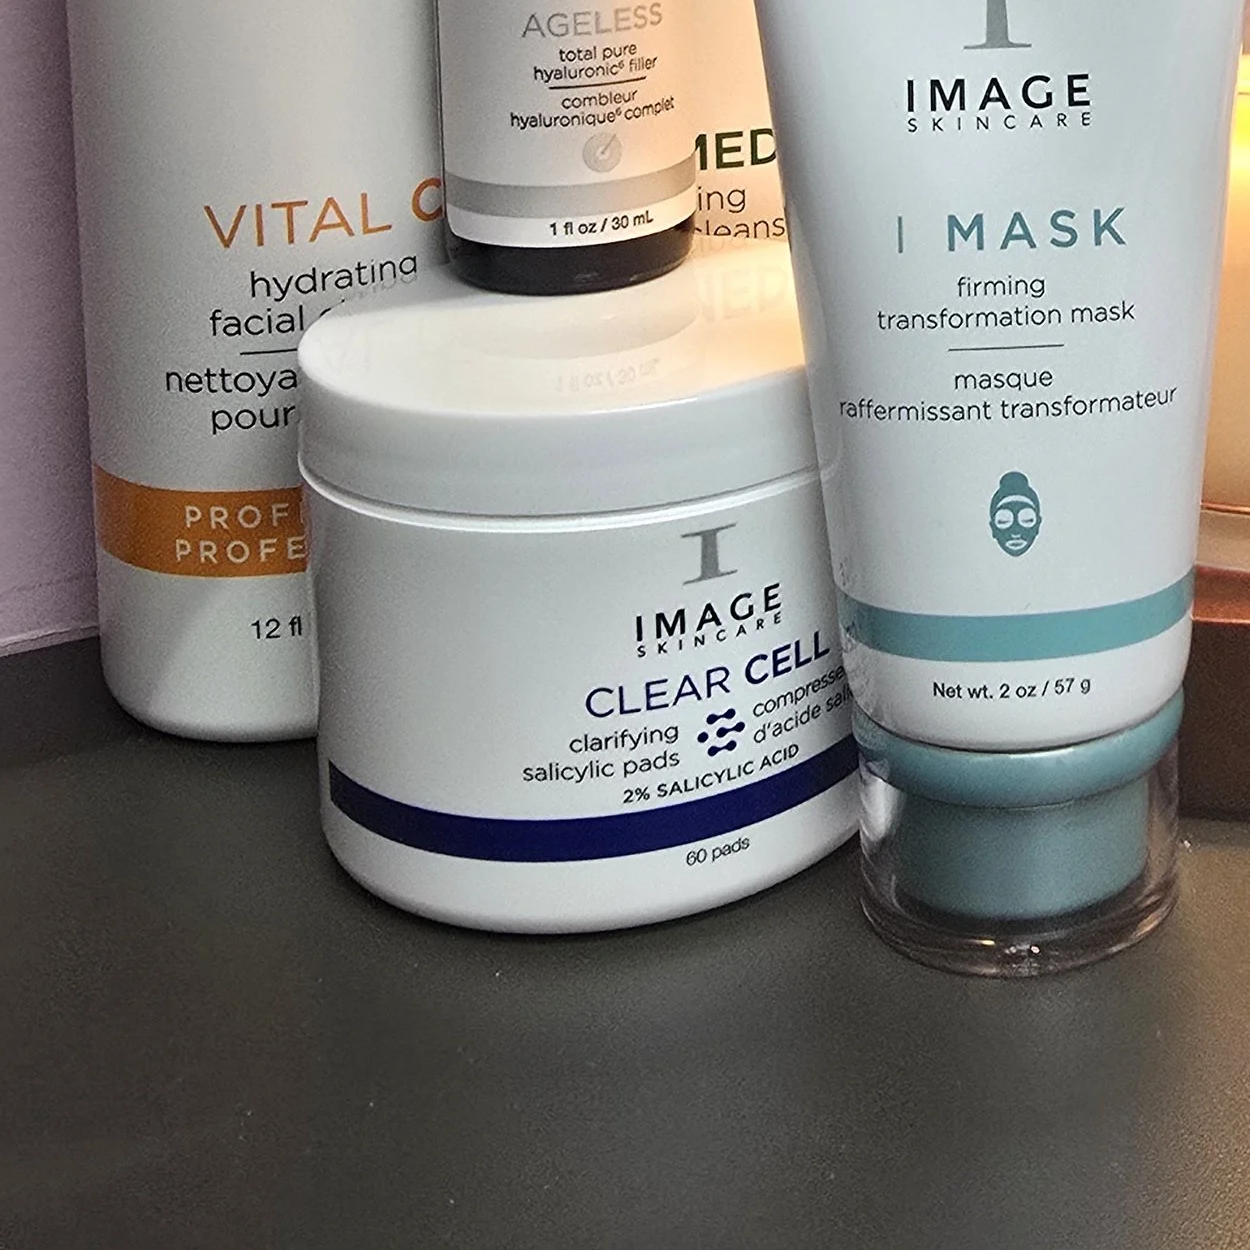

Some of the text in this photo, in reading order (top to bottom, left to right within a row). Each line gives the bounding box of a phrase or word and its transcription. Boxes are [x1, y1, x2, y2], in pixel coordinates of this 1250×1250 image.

[521, 2, 663, 39] AGELESS
[559, 43, 637, 63] total pure
[629, 56, 658, 72] filler
[561, 90, 638, 111] combleur
[624, 96, 675, 121] complet
[907, 73, 1091, 113] IMAGE
[907, 111, 1091, 133] SKINCARE
[203, 177, 442, 249] VITAL C
[550, 210, 654, 236] 1 fl oz / 30 mL
[947, 206, 1127, 252] MASK
[250, 255, 418, 302] hydrating
[957, 274, 1046, 298] firming
[210, 304, 305, 336] facial
[877, 300, 1136, 330] transformation mask
[954, 369, 1053, 392] masque
[211, 404, 296, 435] pour
[839, 386, 1178, 422] raffermissant transformateur
[251, 615, 302, 639] 12 fl
[635, 583, 783, 642] IMAGE
[637, 611, 783, 658] SKINCARE
[585, 630, 831, 718] CLEAR CELL
[933, 678, 1091, 700] Net wt. 2 oz / 57 g
[569, 723, 680, 754] clarifying
[523, 751, 681, 784] salicylic pads
[623, 744, 800, 805] 2% SALICYLIC ACID
[686, 836, 751, 867] 60 pads
